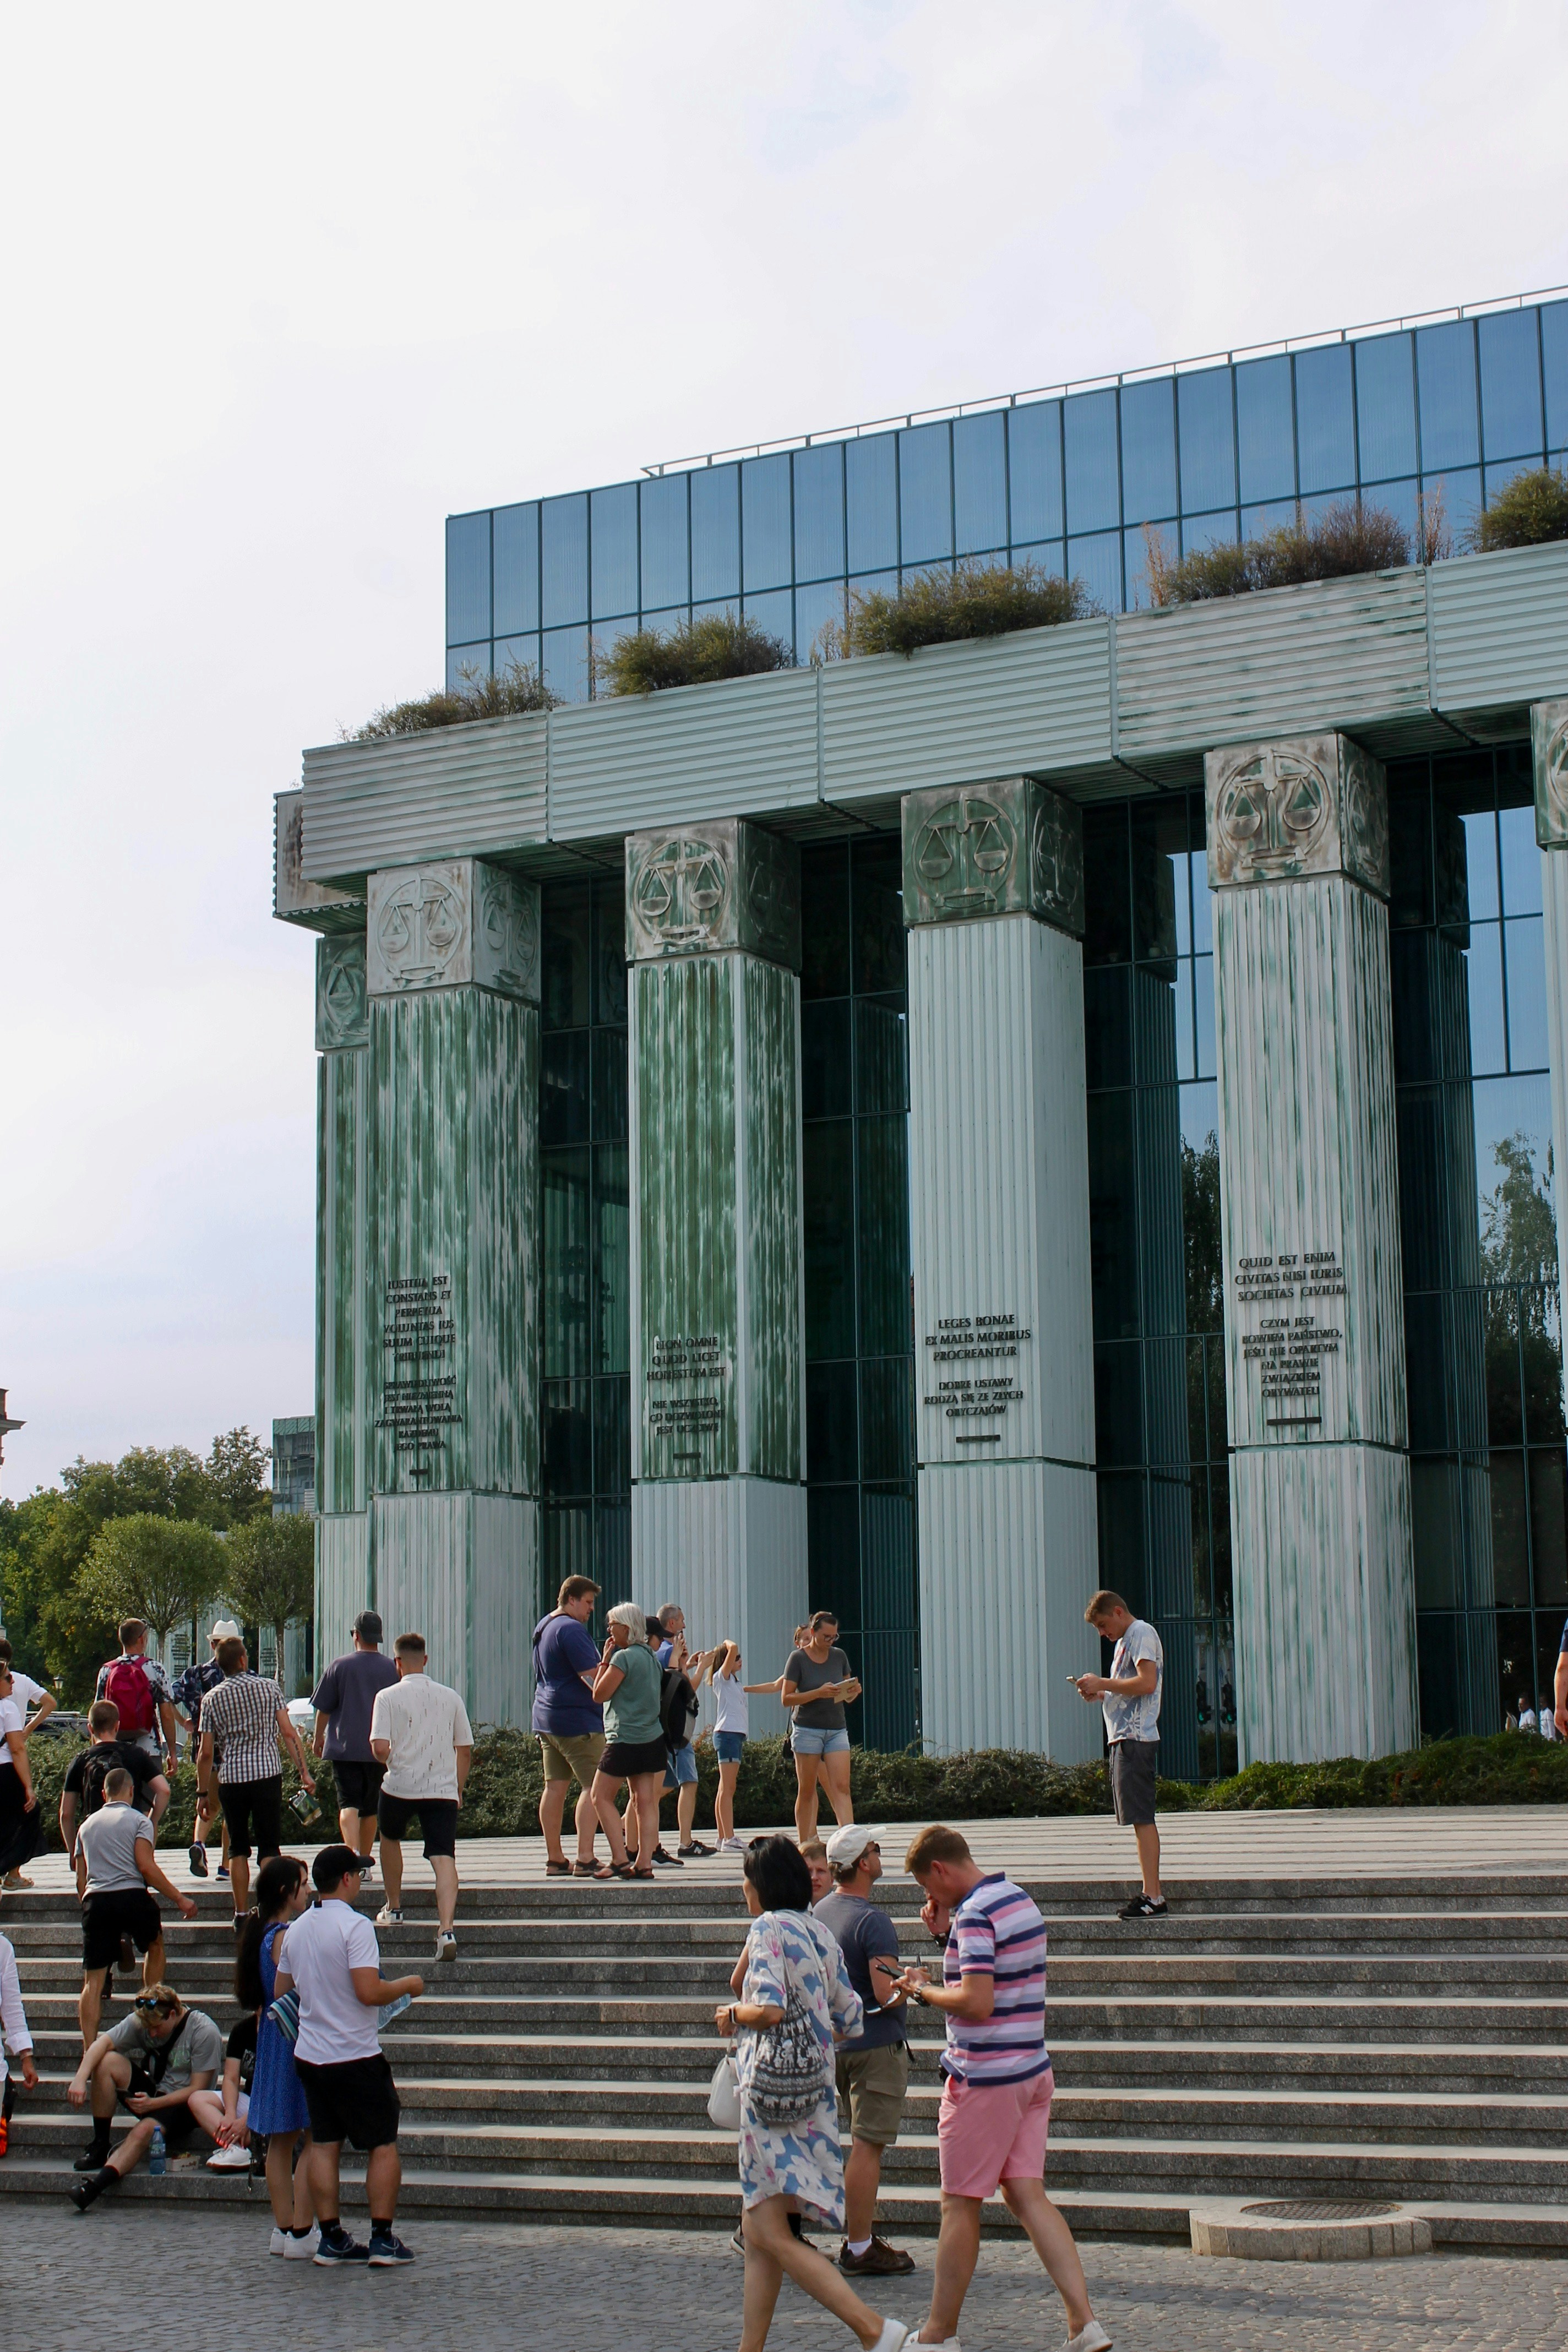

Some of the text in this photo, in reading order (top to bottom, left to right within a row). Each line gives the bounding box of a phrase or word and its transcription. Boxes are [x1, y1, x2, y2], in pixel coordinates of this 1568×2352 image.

[1239, 1252, 1335, 1270] QUID EST ENIM
[433, 1276, 448, 1285] EST
[1235, 1267, 1343, 1285] CIVITAS NISI IURIS
[386, 1291, 451, 1304] CONSTANS ET
[1238, 1284, 1347, 1302] SOCIETAS CIVIUM
[384, 1320, 454, 1333] VOLUNTAS IUS
[938, 1314, 1015, 1329] LEGES BONAE
[1261, 1316, 1315, 1328] CZYM JEST
[383, 1334, 455, 1348] SUUM CUIQUE
[686, 1337, 717, 1347] OMNE
[925, 1330, 1031, 1346] EX MALIS MORIBUS
[1242, 1329, 1342, 1343] BOWIEM PAŃSTWO,
[934, 1347, 1017, 1361] PROCREANTUR
[1270, 1346, 1286, 1355] NIE
[1289, 1343, 1338, 1355] OPARTYM
[652, 1352, 720, 1366] QUOD LICET
[1262, 1358, 1319, 1369] NA PRAWIE
[647, 1367, 726, 1380] HONESTUM EST
[1262, 1372, 1320, 1384] ZWIĄZKIEM
[939, 1378, 1013, 1390] DOBRE USTAWY
[924, 1395, 958, 1404] RODZĄ
[961, 1393, 974, 1403] SIĘ
[977, 1392, 989, 1401] ZE
[946, 1403, 1006, 1417] OBYCZAJÓW
[650, 1413, 663, 1422] CO
[657, 1425, 673, 1435] JEST
